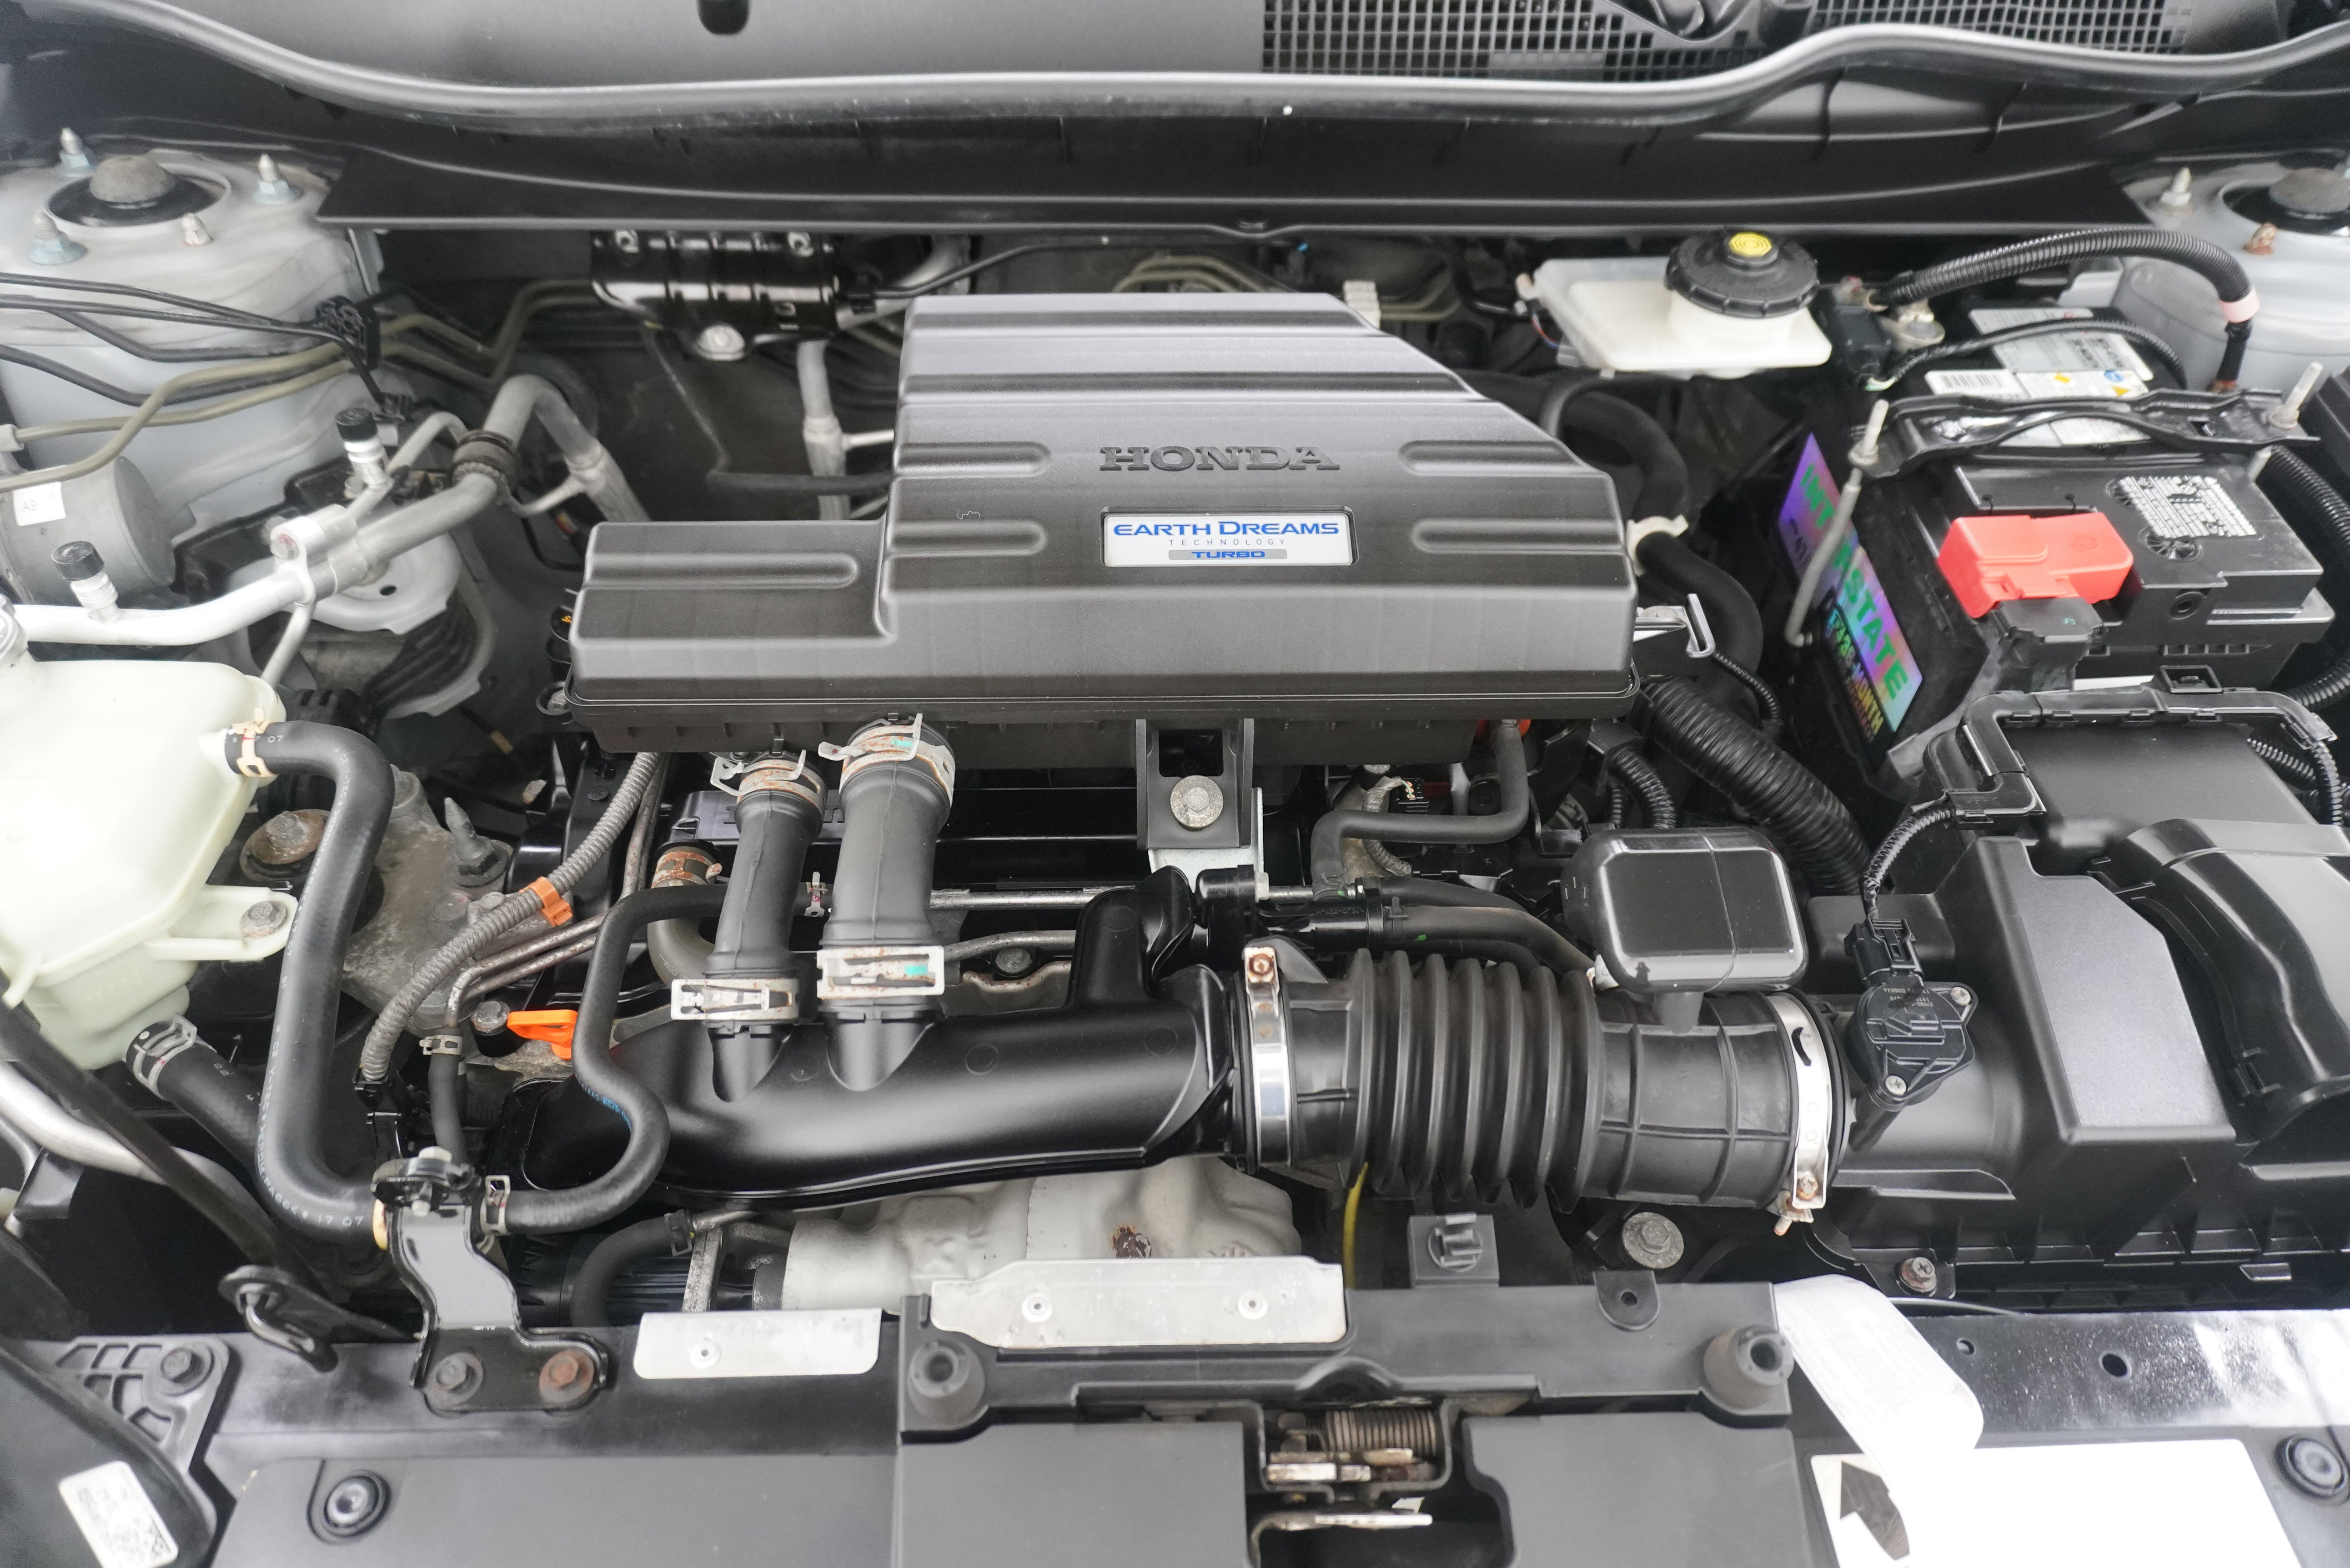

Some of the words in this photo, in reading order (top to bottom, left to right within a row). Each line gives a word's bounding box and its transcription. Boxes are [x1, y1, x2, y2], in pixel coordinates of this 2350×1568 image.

[1100, 446, 1341, 471] HONDA
[1114, 523, 1212, 536] EARTH
[1219, 521, 1340, 535] DREAMS
[1190, 550, 1266, 559] TURBO
[267, 735, 284, 743] 07
[319, 1214, 335, 1225] 17
[342, 1216, 364, 1227] 07
